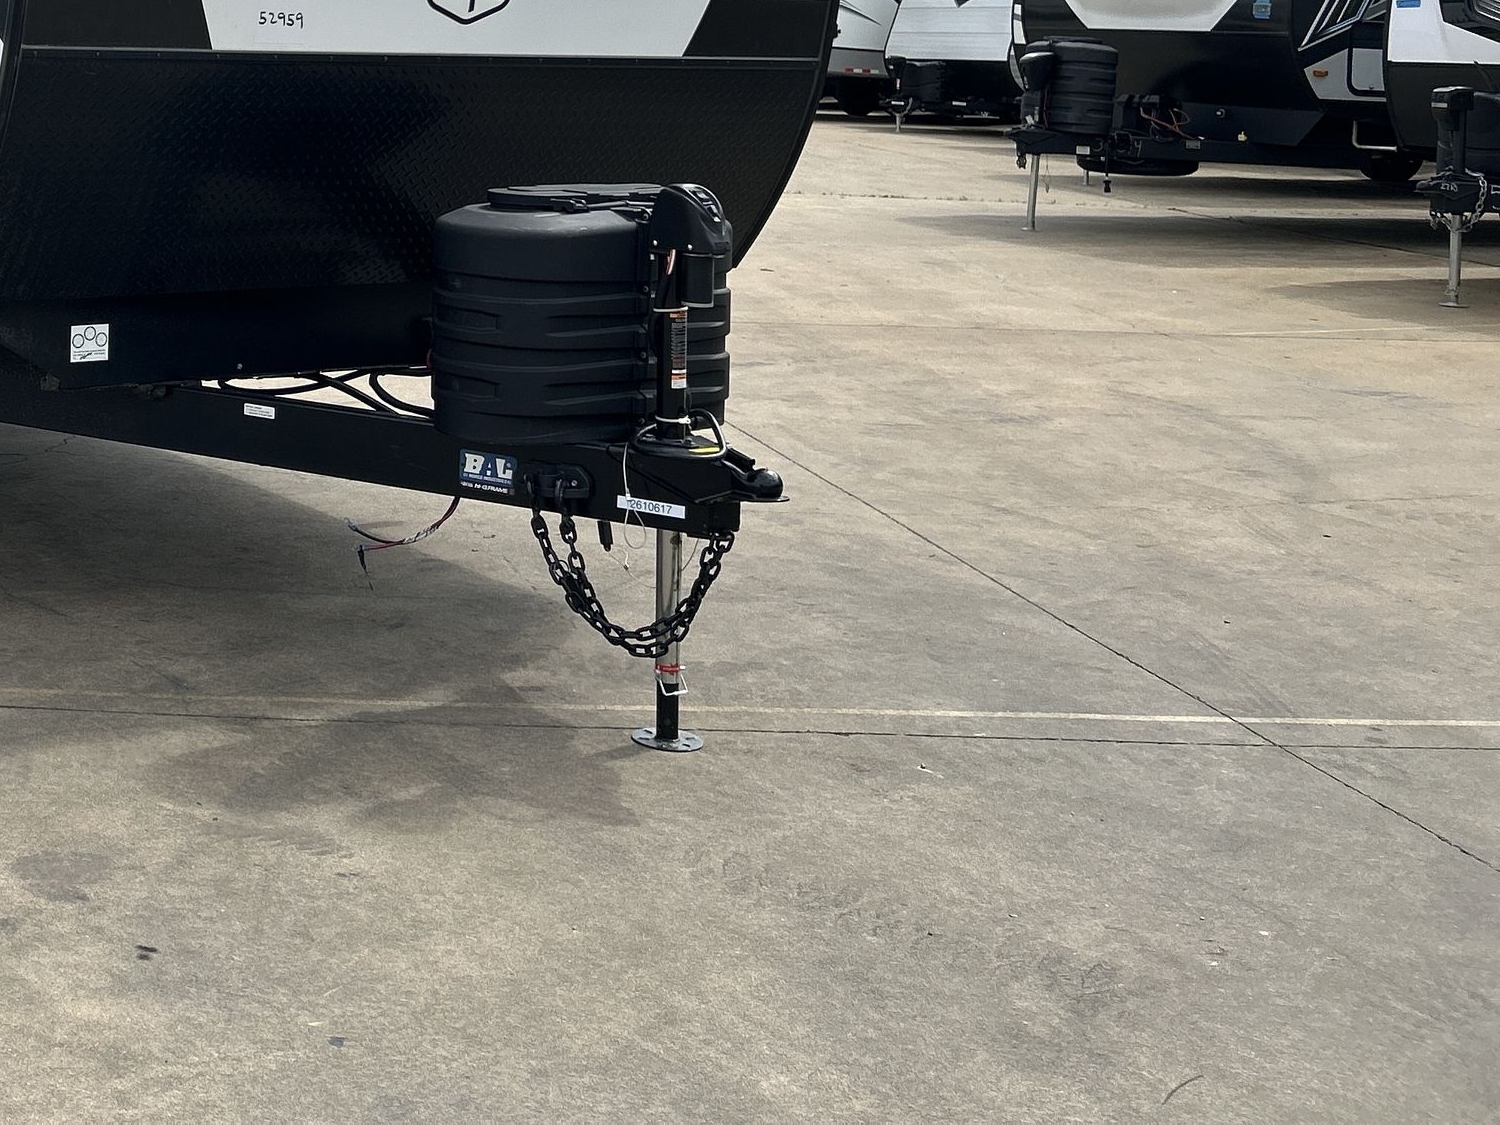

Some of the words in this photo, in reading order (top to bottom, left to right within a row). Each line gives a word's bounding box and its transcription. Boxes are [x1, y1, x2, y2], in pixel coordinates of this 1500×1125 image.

[258, 11, 304, 29] 52959
[463, 452, 513, 480] BAL
[629, 498, 673, 515] 2610617
